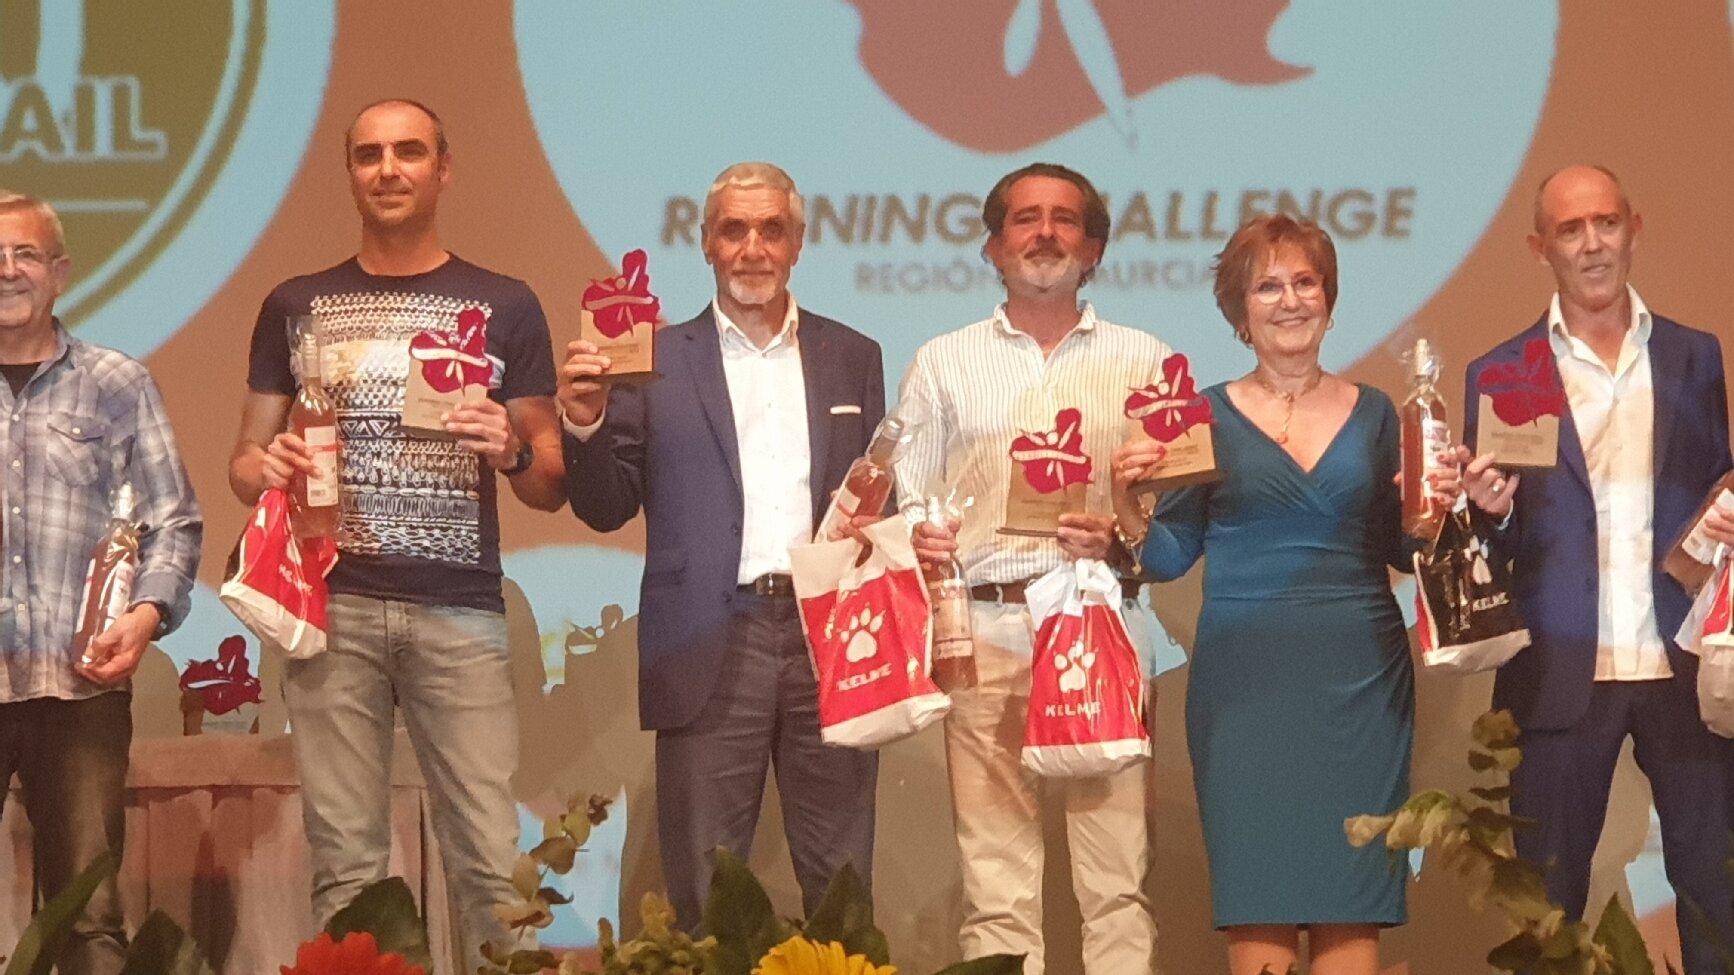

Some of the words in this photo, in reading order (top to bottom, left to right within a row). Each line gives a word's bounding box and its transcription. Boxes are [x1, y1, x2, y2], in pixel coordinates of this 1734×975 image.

[0, 75, 169, 163] AIL
[659, 190, 985, 248] RNING
[1099, 185, 1418, 242] ALLENGE
[836, 662, 893, 693] KELME
[1044, 701, 1102, 718] KELME
